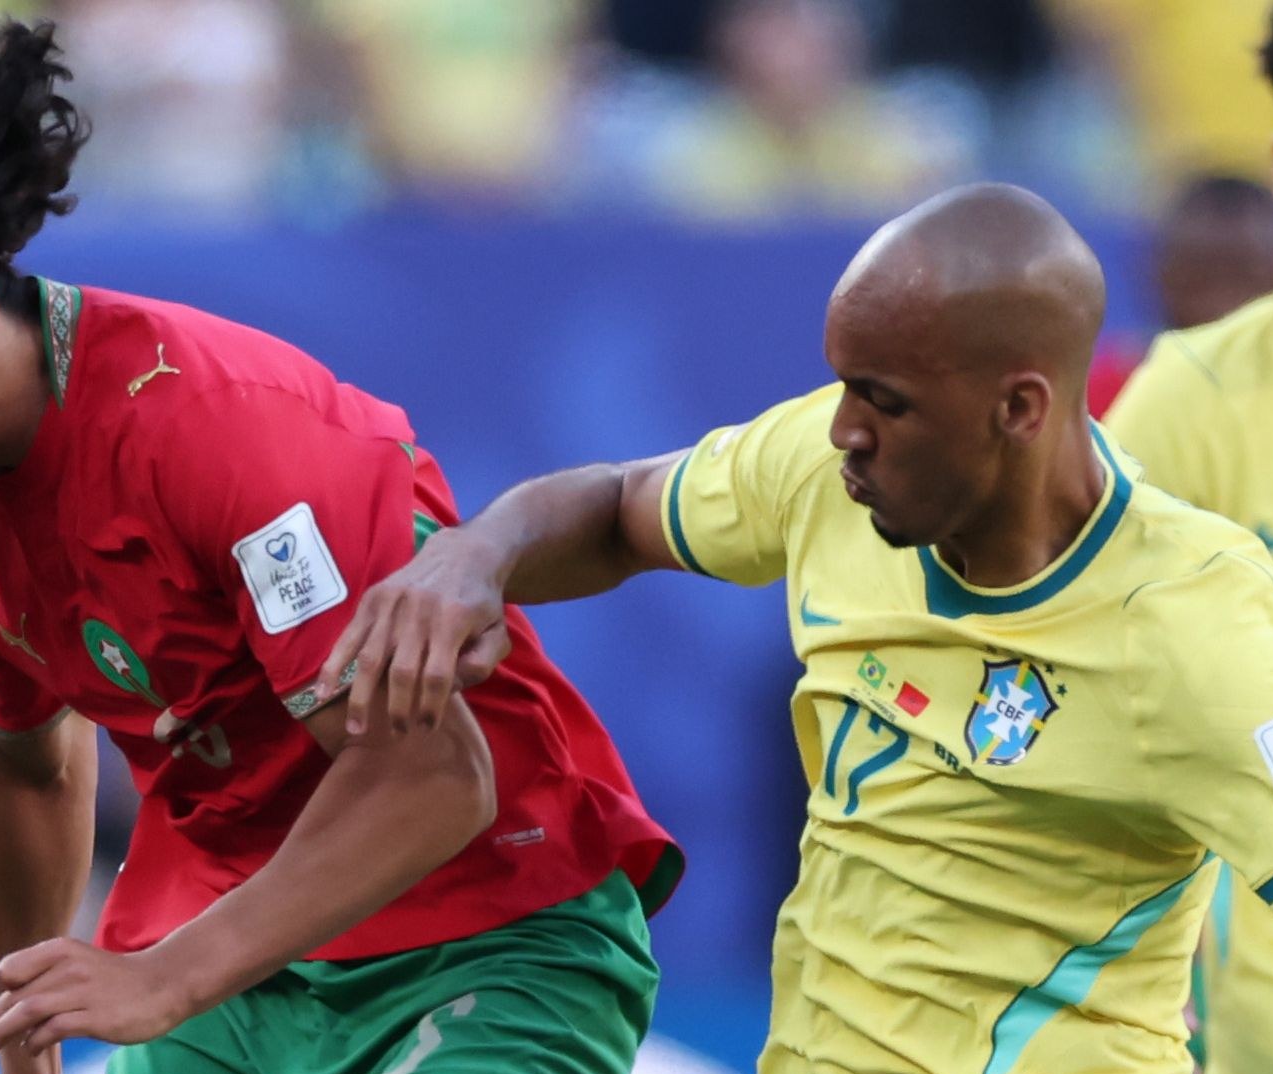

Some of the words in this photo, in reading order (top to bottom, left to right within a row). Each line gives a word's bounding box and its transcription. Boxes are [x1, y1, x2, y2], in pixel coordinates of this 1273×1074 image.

[278, 574, 315, 604] PEACE
[995, 698, 1025, 723] CBF
[824, 695, 910, 817] 17
